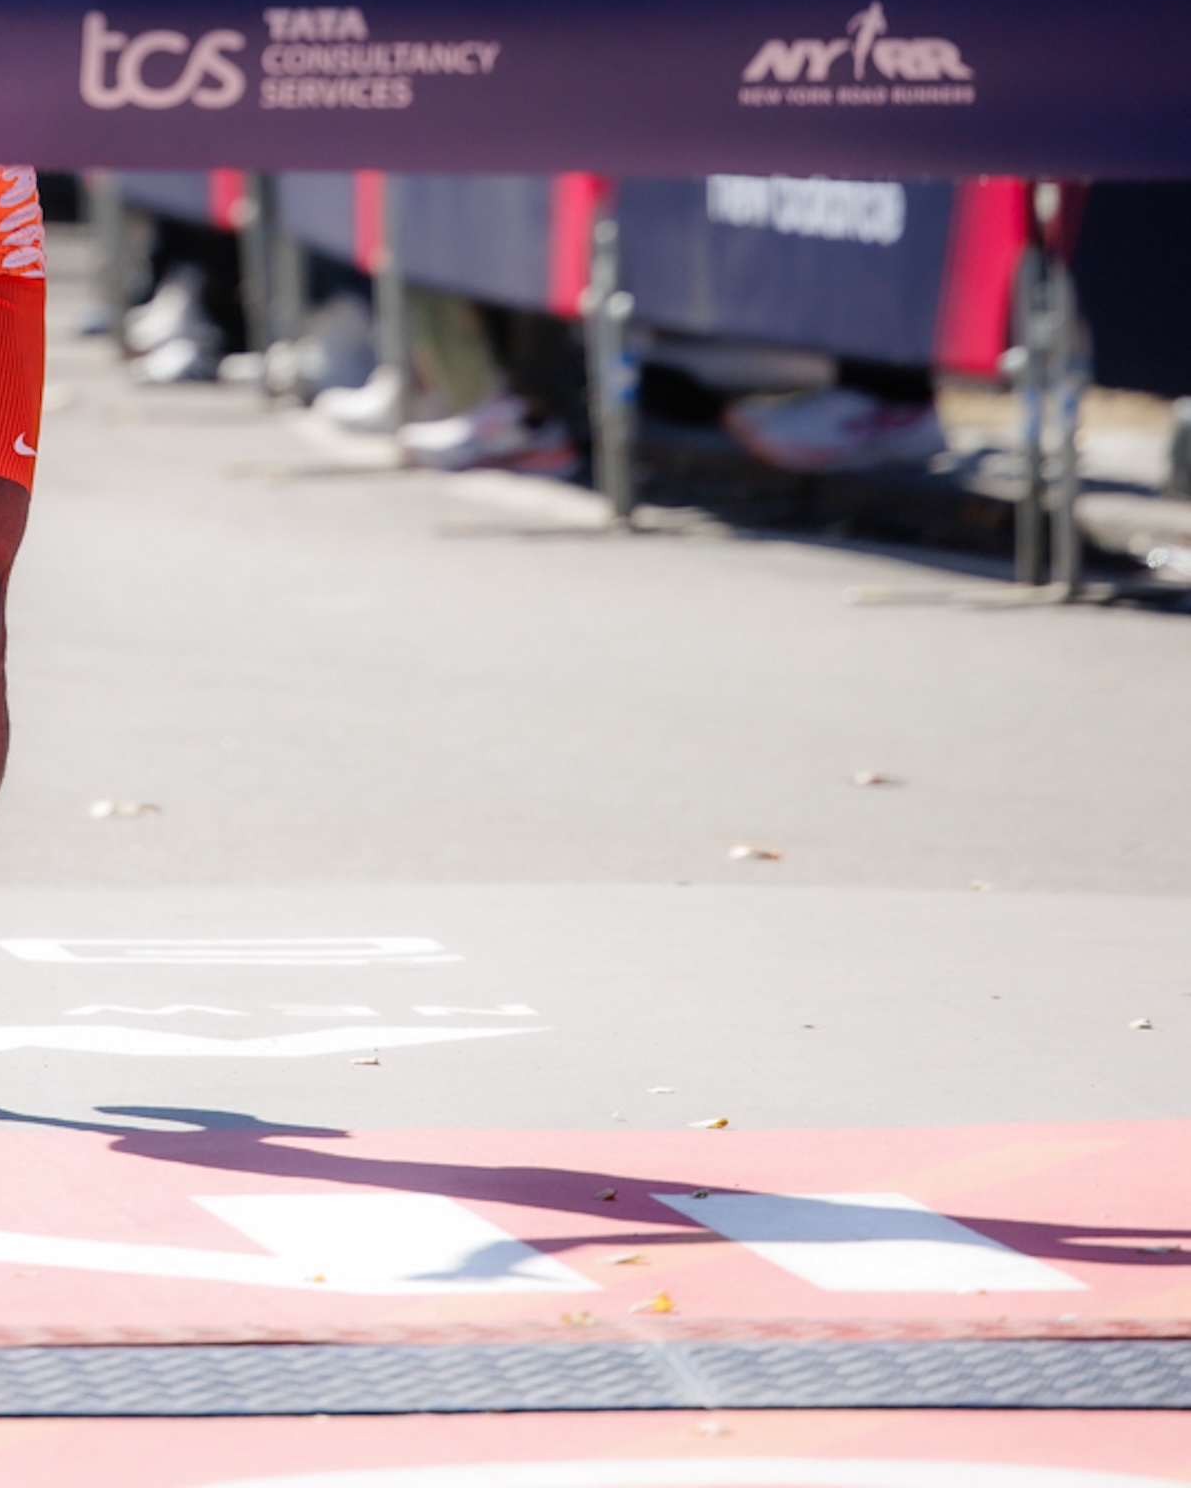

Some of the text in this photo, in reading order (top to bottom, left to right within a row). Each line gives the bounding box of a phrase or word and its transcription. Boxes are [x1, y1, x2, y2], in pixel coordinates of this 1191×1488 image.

[263, 8, 367, 41] TATA
[80, 11, 245, 108] tcs
[261, 42, 500, 75] CONSULTANCY
[260, 75, 412, 109] SERVICES
[738, 84, 976, 106] NEW YORK ROAD RUNNERS
